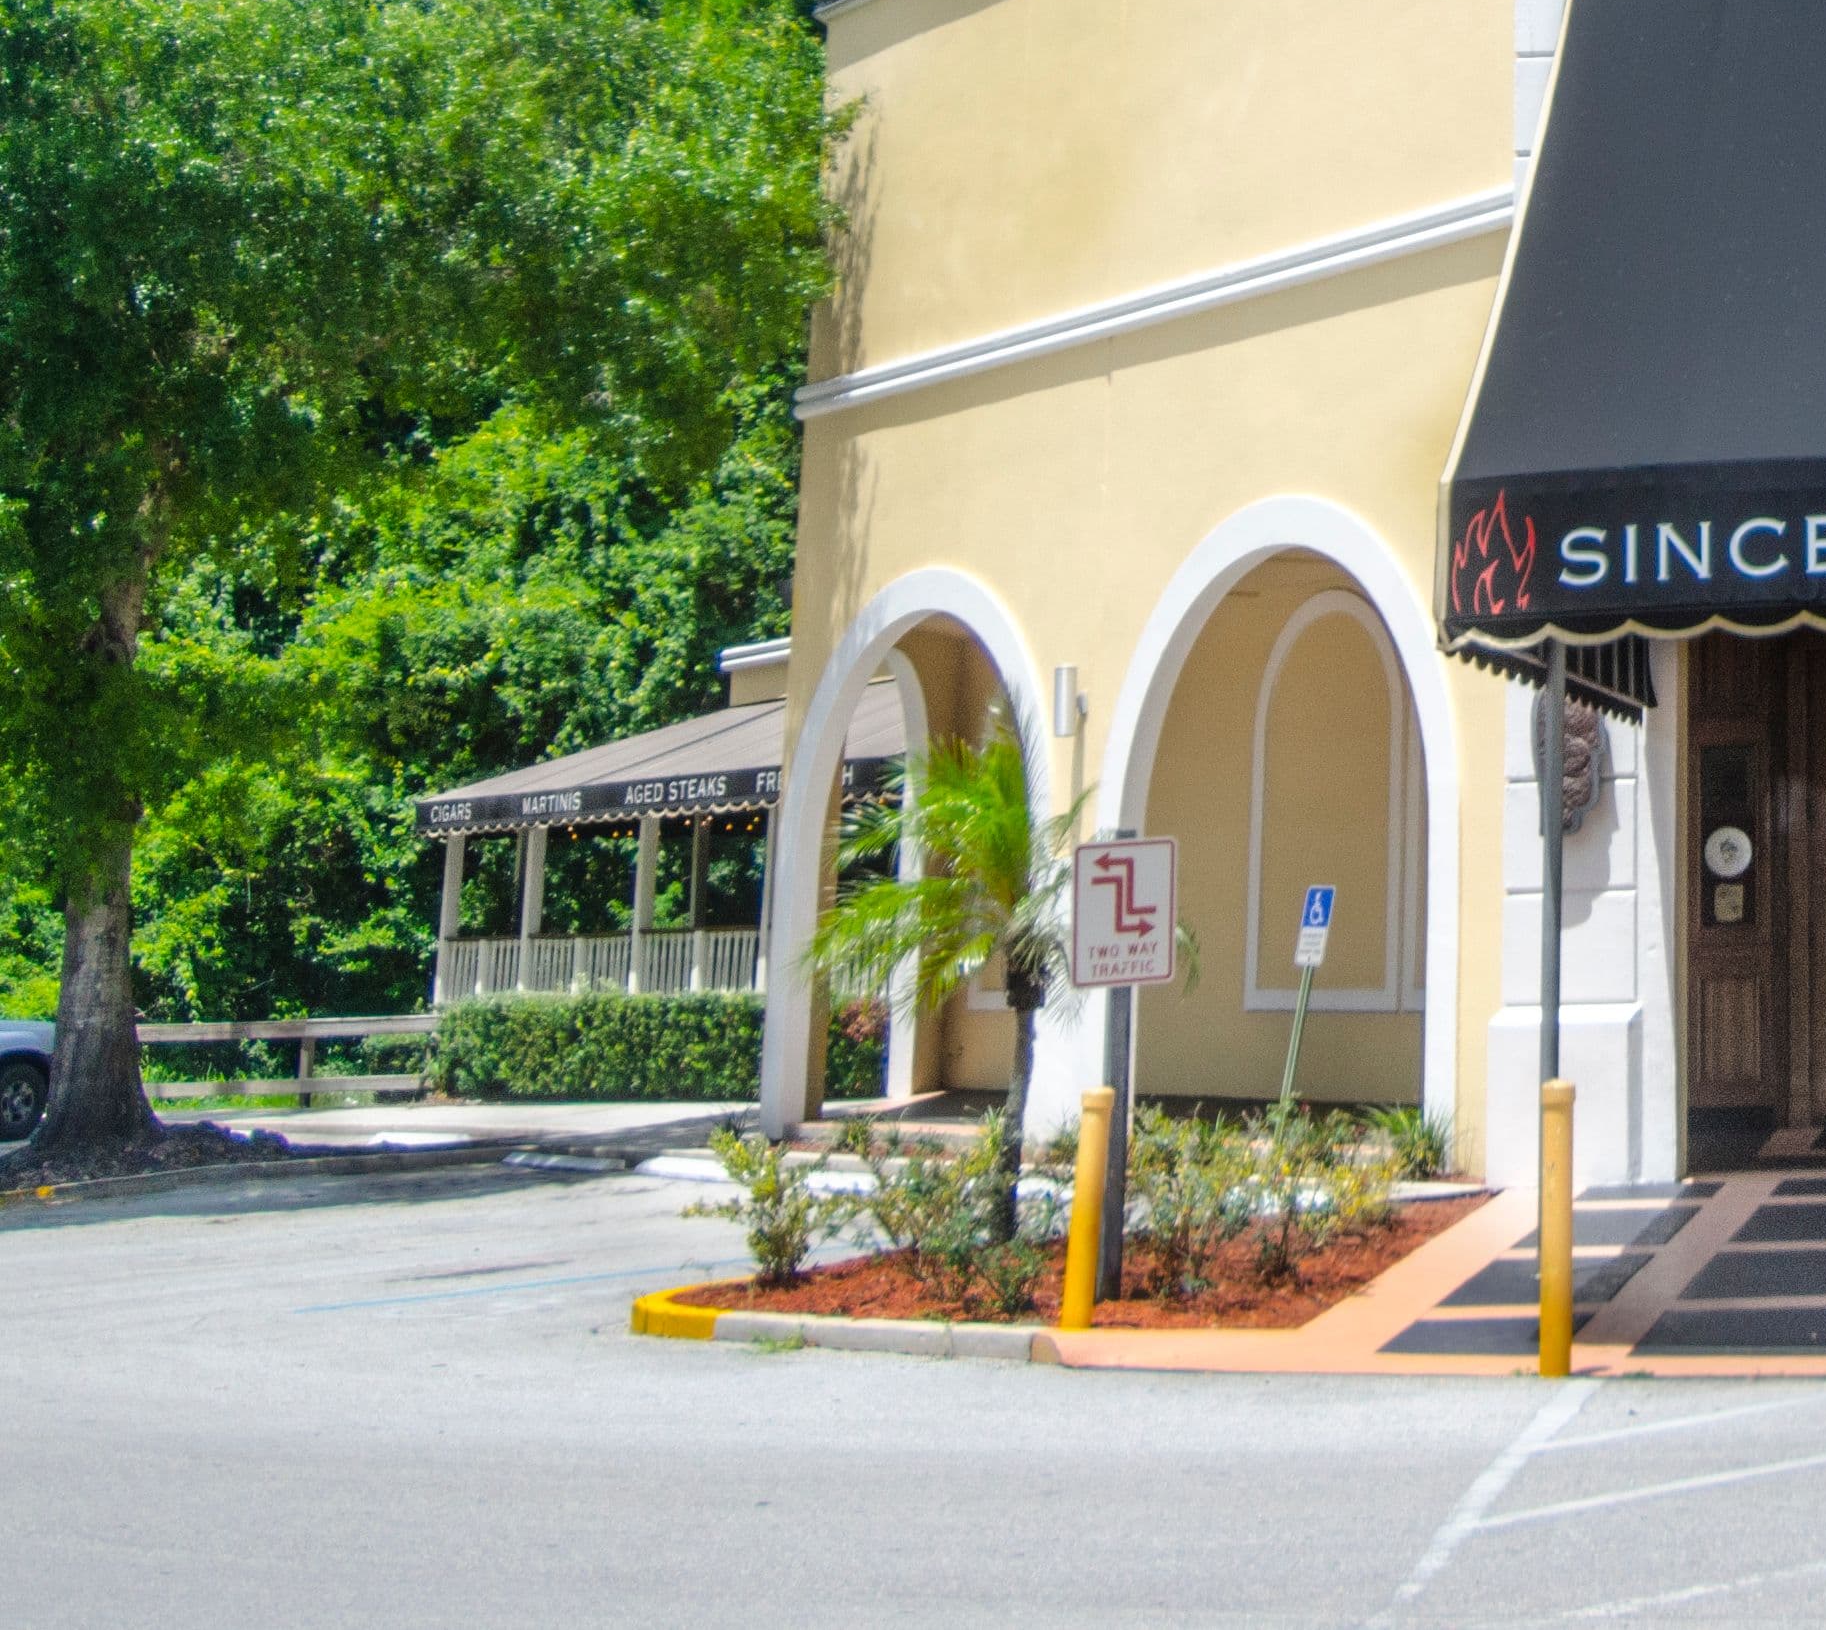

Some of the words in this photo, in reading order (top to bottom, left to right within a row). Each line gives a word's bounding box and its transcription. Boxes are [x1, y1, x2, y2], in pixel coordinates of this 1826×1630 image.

[430, 802, 472, 823] CIGARS
[522, 791, 582, 815] MARTINIS
[624, 783, 665, 805] AGED
[668, 775, 727, 801] STEAKS
[1087, 945, 1119, 960] TWO
[1127, 941, 1157, 957] WAY
[1091, 959, 1154, 978] TRAFFIC
